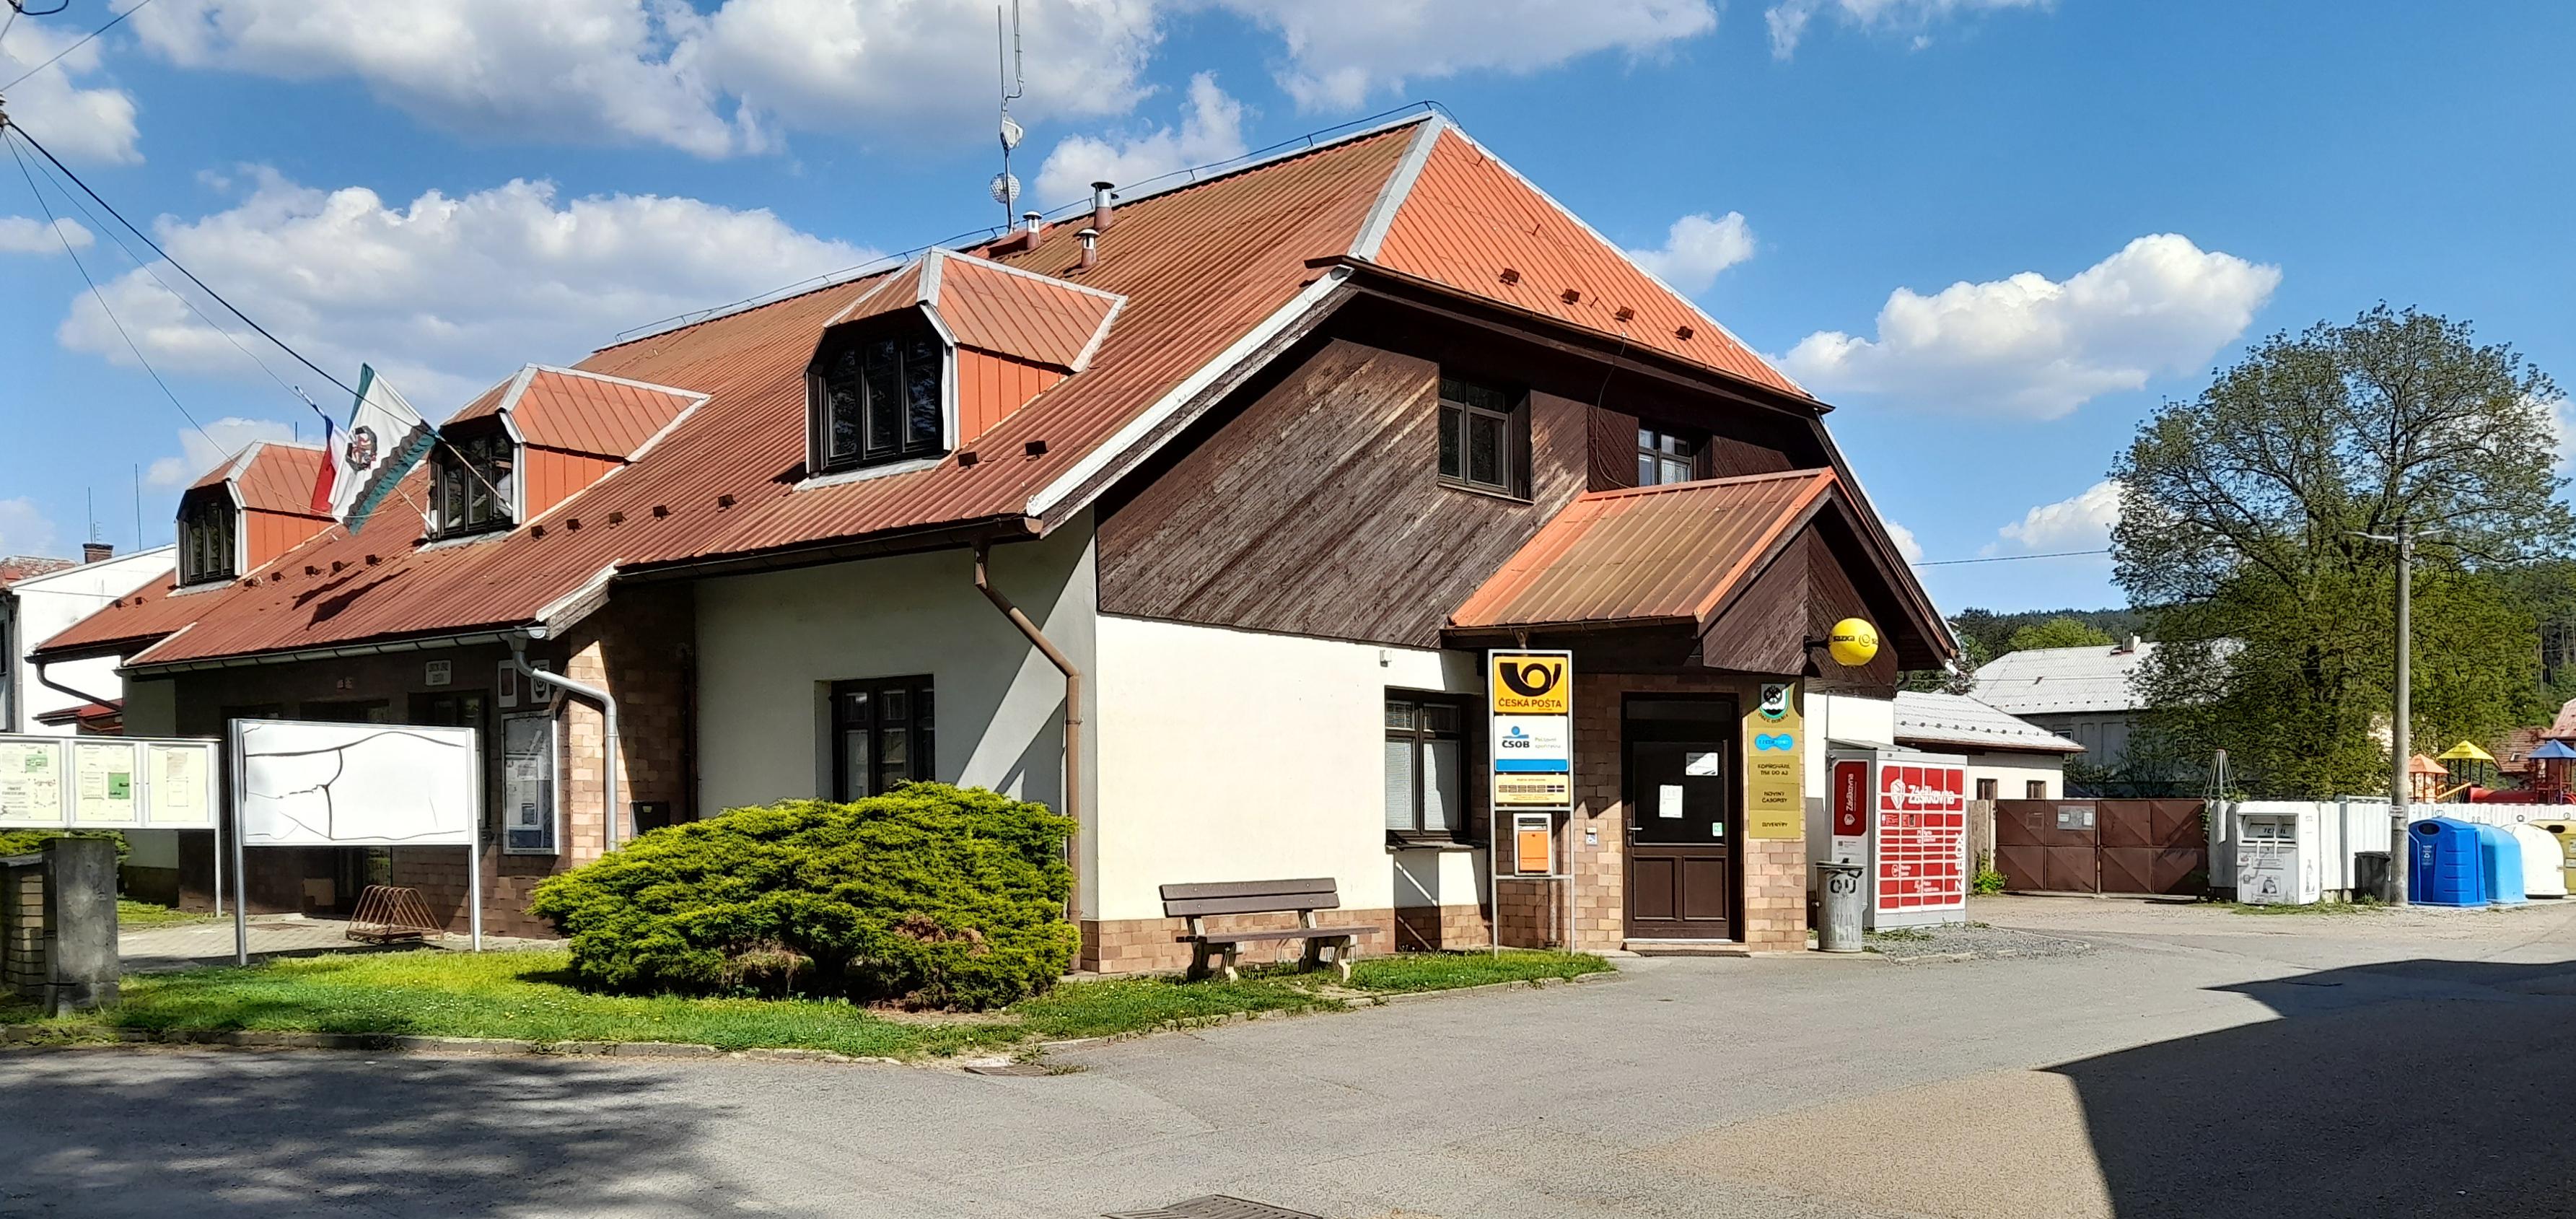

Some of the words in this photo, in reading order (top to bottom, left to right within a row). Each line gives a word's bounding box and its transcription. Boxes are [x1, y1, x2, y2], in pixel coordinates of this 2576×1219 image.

[1498, 697, 1530, 707] ČESKÁ
[1531, 698, 1562, 708] POŠTA
[1502, 740, 1530, 748] ČSOB
[1846, 773, 1854, 811] Zásilkovna
[1908, 785, 1955, 805] Zásilkovna
